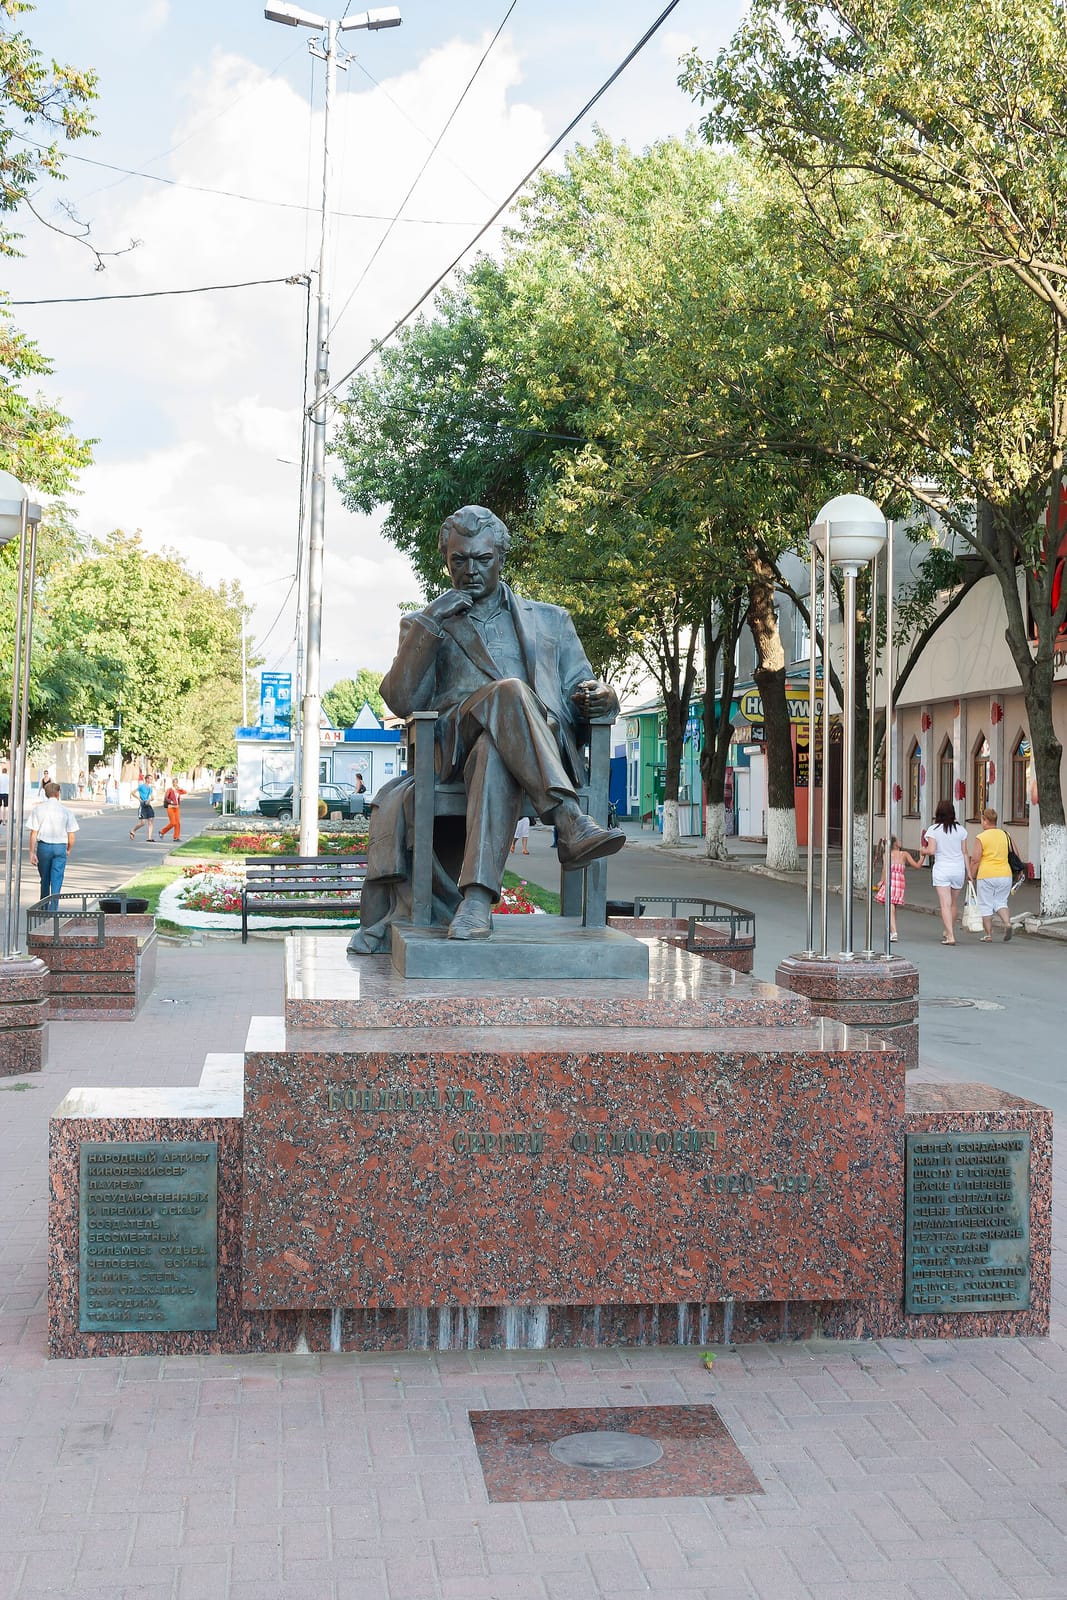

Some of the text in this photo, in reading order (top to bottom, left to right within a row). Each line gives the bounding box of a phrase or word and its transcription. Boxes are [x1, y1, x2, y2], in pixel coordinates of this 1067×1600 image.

[328, 1089, 477, 1112] БОНДАРЧУК
[453, 1122, 718, 1154] СЕРГЕЙ ФЕДОРОВИЧ
[914, 1141, 1023, 1154] СЕРГЕЙ БОНДАРЧУК
[88, 1152, 209, 1164] НАРОДНЫЙ АРТИСТ
[914, 1155, 1007, 1167] ЖИЛ И ОКОНЧИЛ
[88, 1167, 187, 1177] КИНОРЕЖИССЕР
[914, 1168, 1010, 1179] ШКОЛУ В ГОРОДЕ
[88, 1180, 143, 1190] ЛАУРЕАТ
[914, 1180, 1012, 1192] ЕЙСКЕ И ПЕРВЫЕ
[88, 1193, 209, 1203] ГОСУДАРСТВЕННЫХ
[914, 1193, 1012, 1204] РОЛИ СЫГРАЛ НА
[88, 1206, 201, 1216] И ПРЕМИИ ОСКАР
[913, 1204, 1005, 1217] СЦЕНЕ ЕЙСКОГО
[88, 1219, 160, 1230] СОЗДАТЕЛЬ
[914, 1218, 1011, 1231] ДРАМАТИЧЕСКОГО
[88, 1232, 180, 1242] БЕССМЕРТНЫХ
[962, 1231, 977, 1240] НА
[981, 1229, 1023, 1239] ЭКРАНЕ
[88, 1245, 208, 1256] ФИЛЬМОВ: СУДЬБА
[913, 1243, 988, 1254] ИМ СОЗДАНЫ
[165, 1257, 208, 1269] ВОЙНА
[955, 1256, 988, 1266] ТАРАС
[88, 1272, 97, 1282] И
[913, 1269, 975, 1280] ШЕВЧЕНКО,
[88, 1285, 196, 1296] ОНИ СРАЖАЛИСЬ
[88, 1299, 103, 1309] ЗА
[87, 1309, 130, 1321] ТИХИЙ
